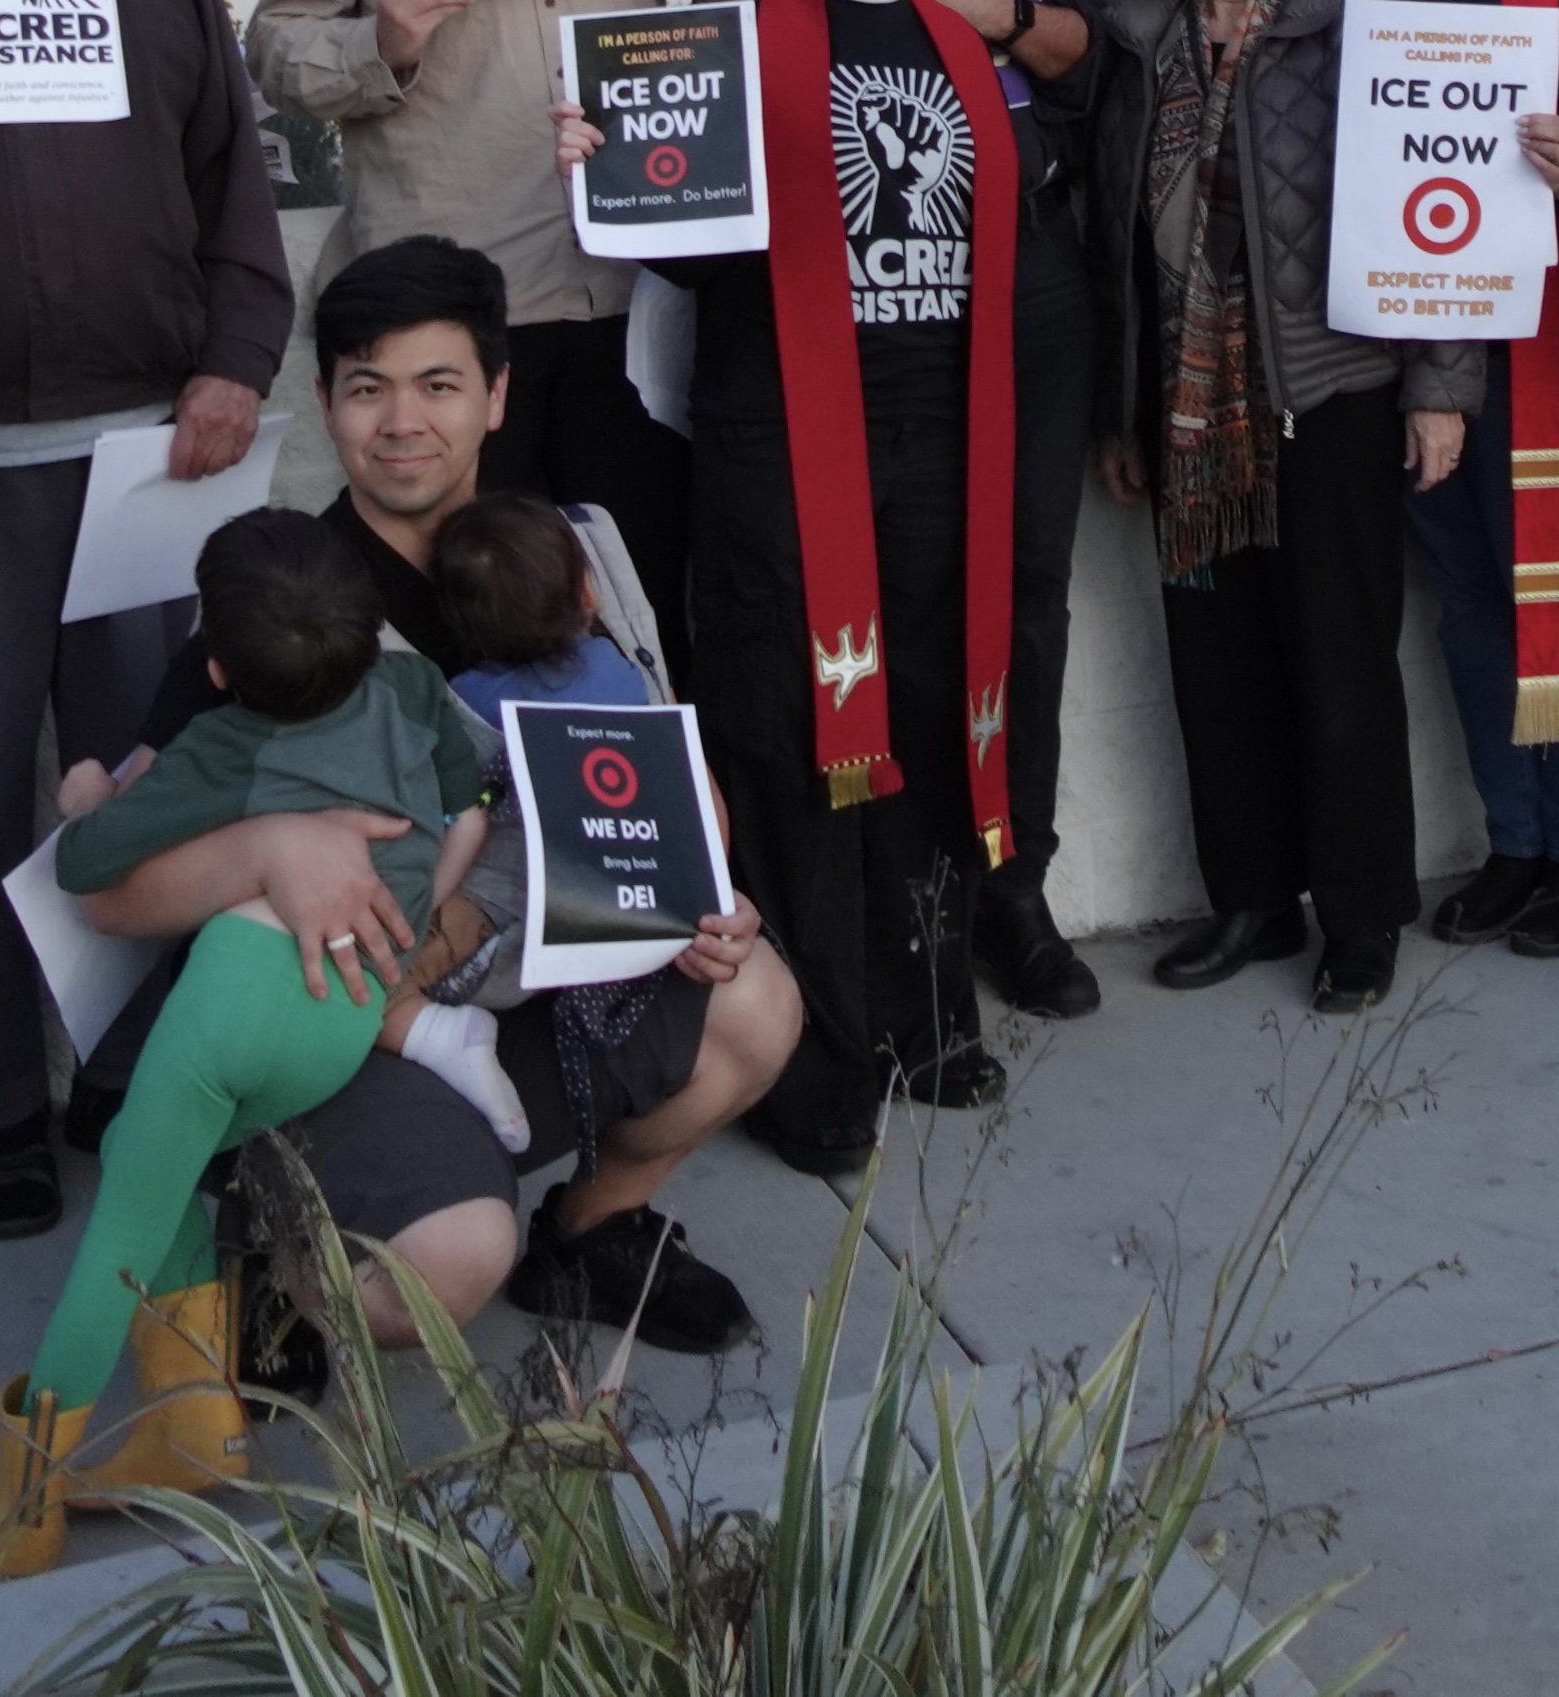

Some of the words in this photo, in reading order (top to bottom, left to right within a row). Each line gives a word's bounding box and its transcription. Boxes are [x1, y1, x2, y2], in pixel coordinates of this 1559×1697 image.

[615, 33, 625, 46] A
[626, 29, 671, 45] PERSON
[673, 28, 687, 42] OF
[689, 26, 719, 40] FAITH
[1376, 30, 1398, 42] AM
[1401, 31, 1411, 42] A
[1414, 32, 1467, 44] PERSON
[1470, 33, 1489, 45] OF
[1492, 34, 1532, 48] FAITH
[622, 50, 668, 66] CALLING
[1405, 50, 1461, 63] CALLING
[1464, 51, 1492, 64] FOR
[3, 80, 27, 92] faith
[31, 81, 49, 90] and
[600, 77, 651, 109] ICE
[658, 71, 725, 103] OUT
[1370, 78, 1431, 108] ICE
[1442, 82, 1528, 112] OUT
[28, 94, 65, 105] against
[622, 107, 708, 142] NOW
[1403, 134, 1499, 165] NOW
[592, 195, 636, 210] Expect
[683, 188, 701, 202] Do
[704, 183, 747, 200] better!
[1368, 271, 1450, 290] EXPECT
[1456, 274, 1514, 291] MORE
[1378, 297, 1407, 314] DO
[1414, 299, 1494, 316] BETTER
[567, 725, 603, 740] Expect
[581, 817, 617, 839] WE
[620, 819, 659, 841] DO!
[603, 856, 631, 872] Bring
[632, 857, 658, 870] back
[617, 885, 656, 909] DEI
